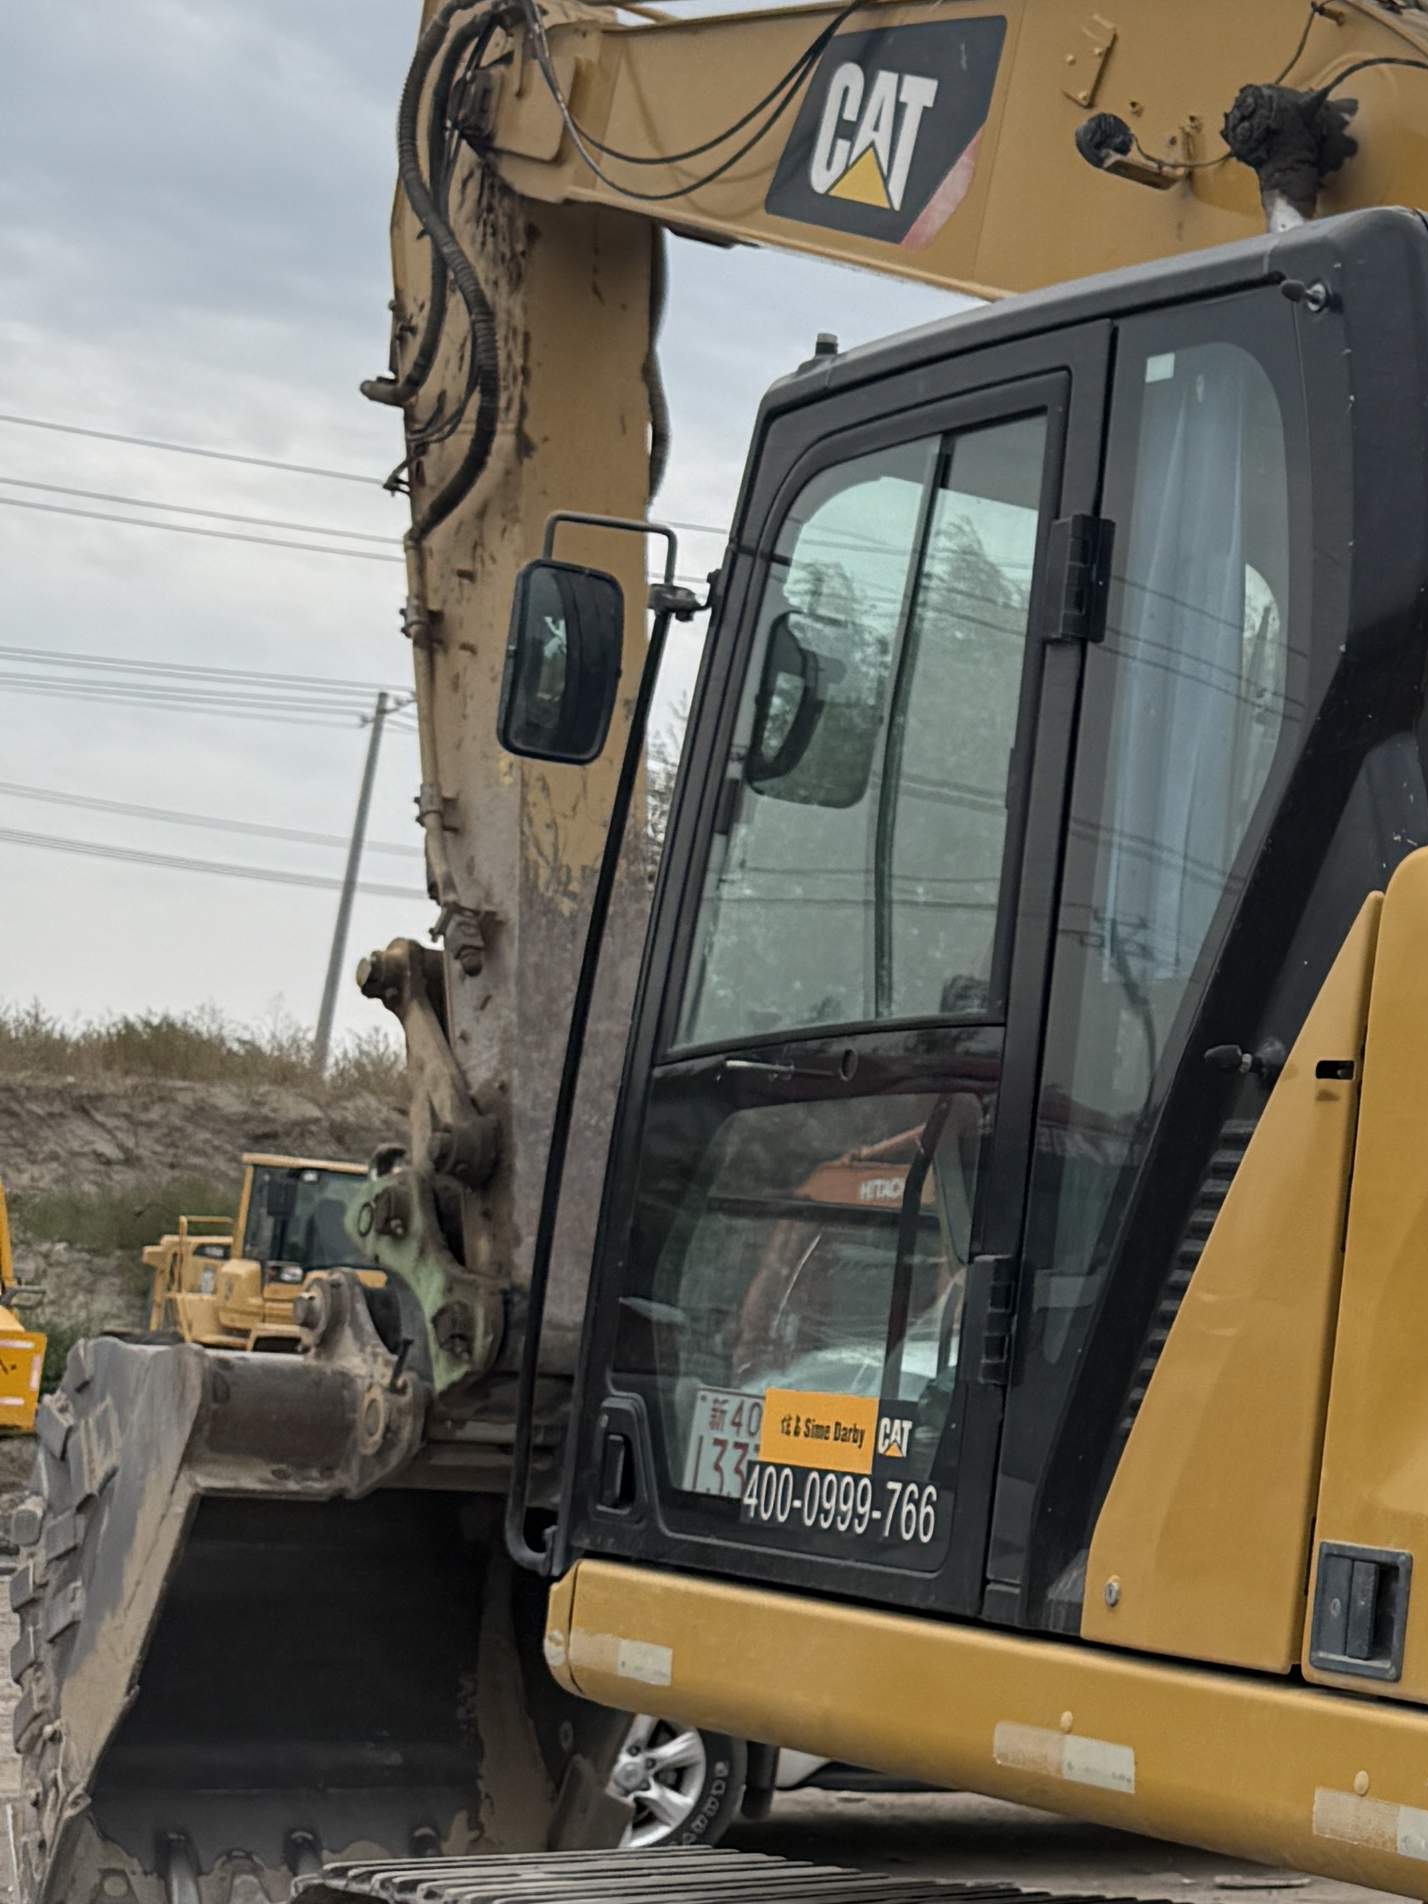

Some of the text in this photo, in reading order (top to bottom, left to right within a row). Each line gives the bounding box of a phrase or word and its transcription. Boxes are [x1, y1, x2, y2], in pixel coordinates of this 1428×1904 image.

[810, 62, 939, 212] CAT
[859, 1178, 907, 1201] HITAC
[803, 1417, 831, 1441] Sime
[833, 1421, 866, 1449] Darby
[878, 1417, 912, 1458] CAT
[743, 1465, 938, 1543] 400-0999-766
